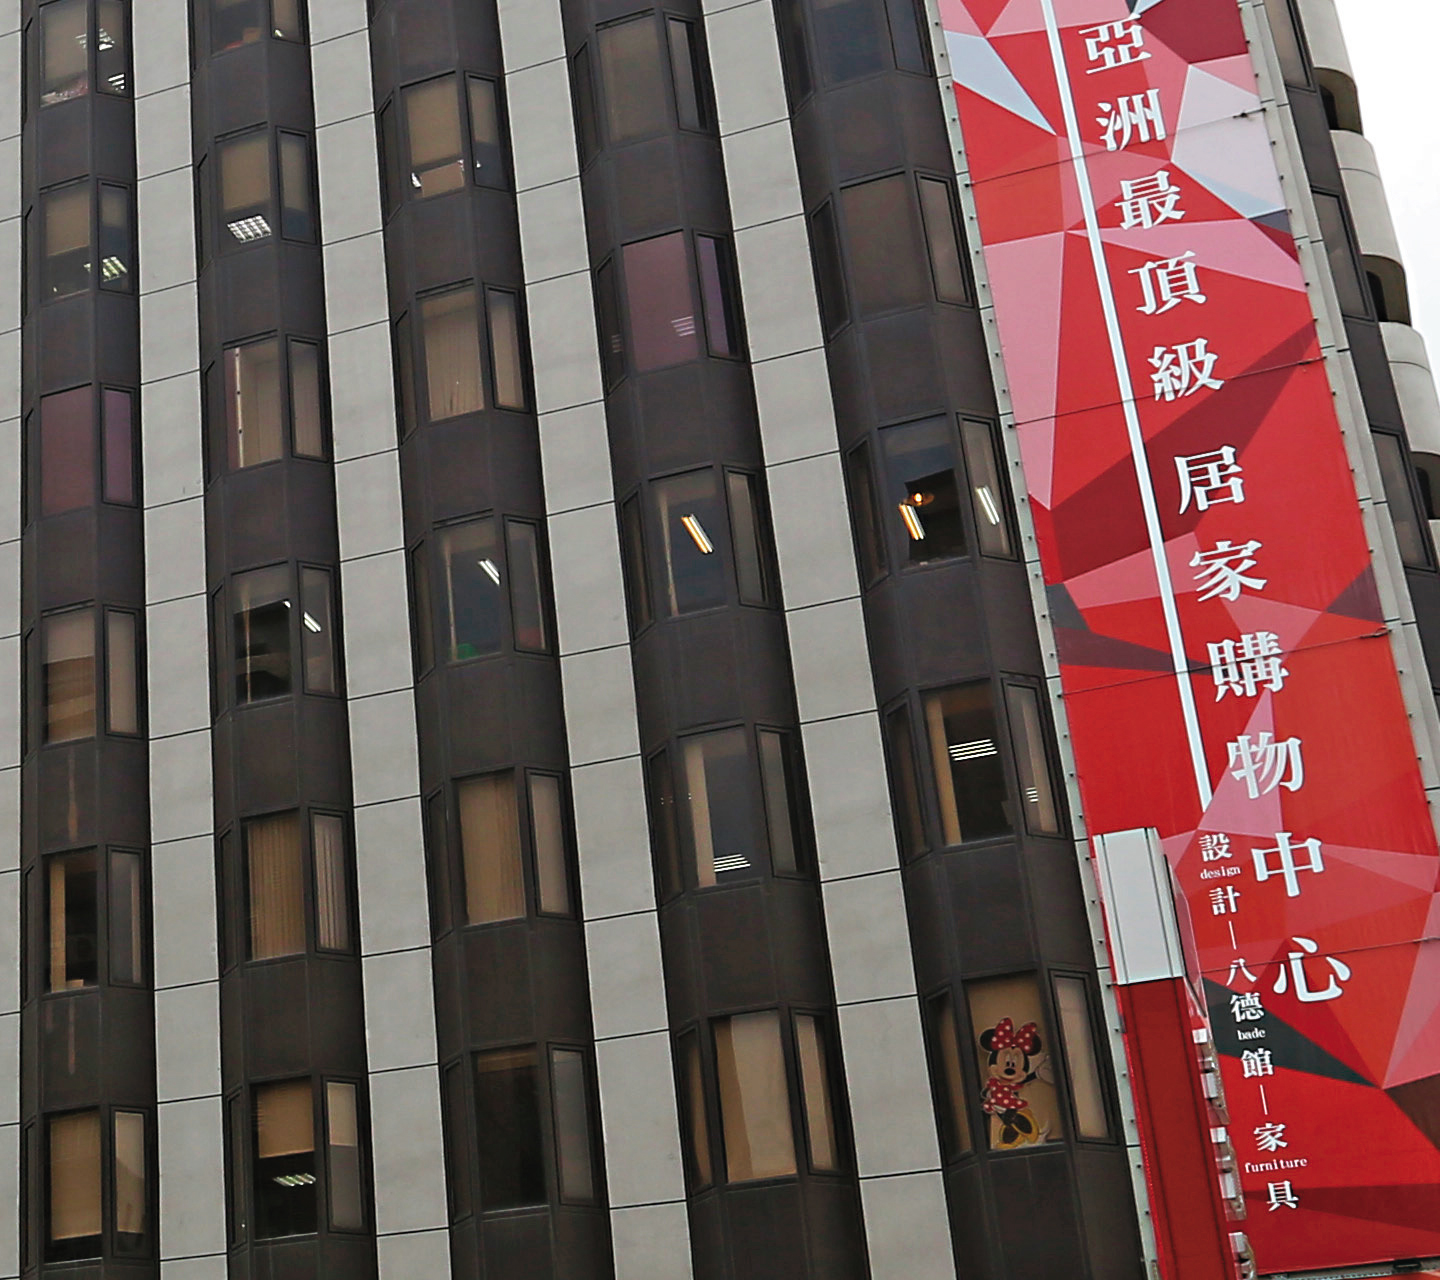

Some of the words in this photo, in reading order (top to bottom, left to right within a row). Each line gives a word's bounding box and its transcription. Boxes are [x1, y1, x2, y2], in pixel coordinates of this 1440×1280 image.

[1200, 865, 1241, 880] design
[1237, 1027, 1266, 1040] bade
[1244, 1156, 1308, 1174] furniture
